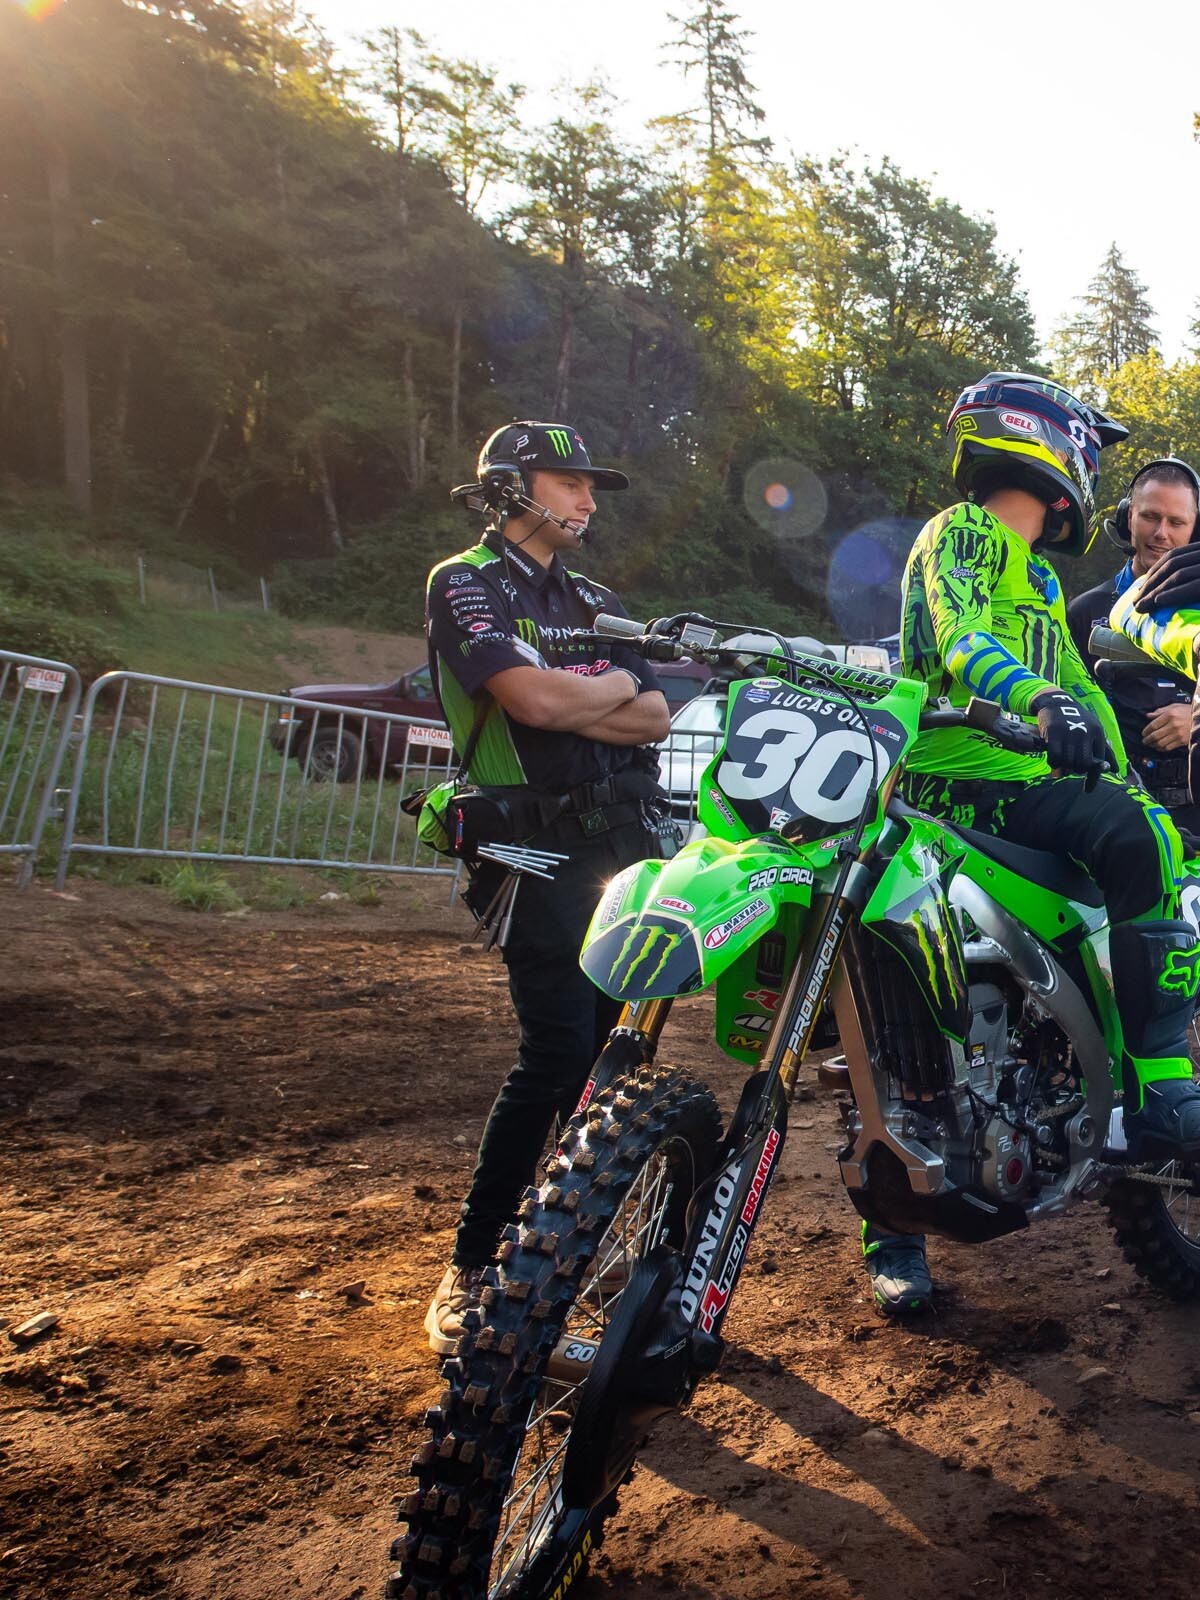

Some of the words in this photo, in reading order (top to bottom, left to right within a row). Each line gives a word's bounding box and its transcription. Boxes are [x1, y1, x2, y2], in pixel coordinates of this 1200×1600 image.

[1005, 414, 1033, 431] BELL
[504, 547, 535, 577] Kawasaki
[770, 691, 837, 716] LUCAS
[836, 708, 869, 731] OIL
[1052, 694, 1088, 734] FOX
[717, 708, 891, 824] 30
[748, 867, 778, 892] PRO
[779, 867, 814, 886] CIRCU
[659, 898, 690, 912] BELL
[723, 898, 765, 934] MAXIMA
[788, 1001, 814, 1056] PRO
[807, 907, 847, 1002] CIRCUIT
[741, 1128, 780, 1226] BRAKING
[564, 1342, 596, 1362] 30
